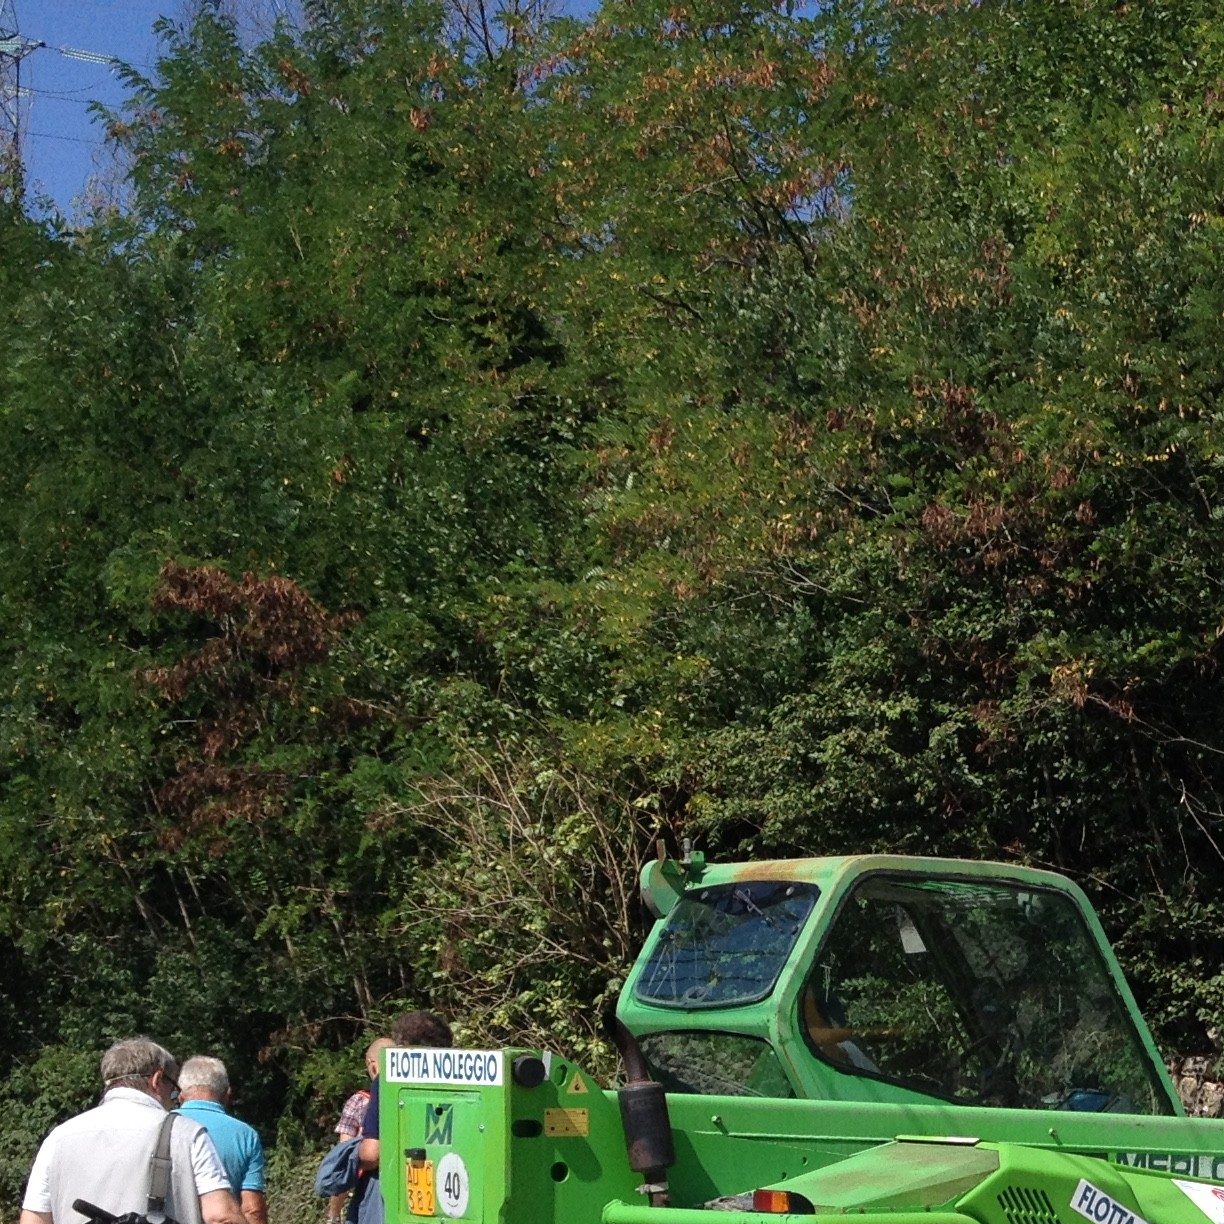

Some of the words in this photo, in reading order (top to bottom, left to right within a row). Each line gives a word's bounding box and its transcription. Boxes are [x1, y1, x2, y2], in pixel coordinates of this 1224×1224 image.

[390, 1051, 430, 1079] FLOTTA
[433, 1053, 497, 1082] NOLEGGIO
[444, 1171, 461, 1201] 40
